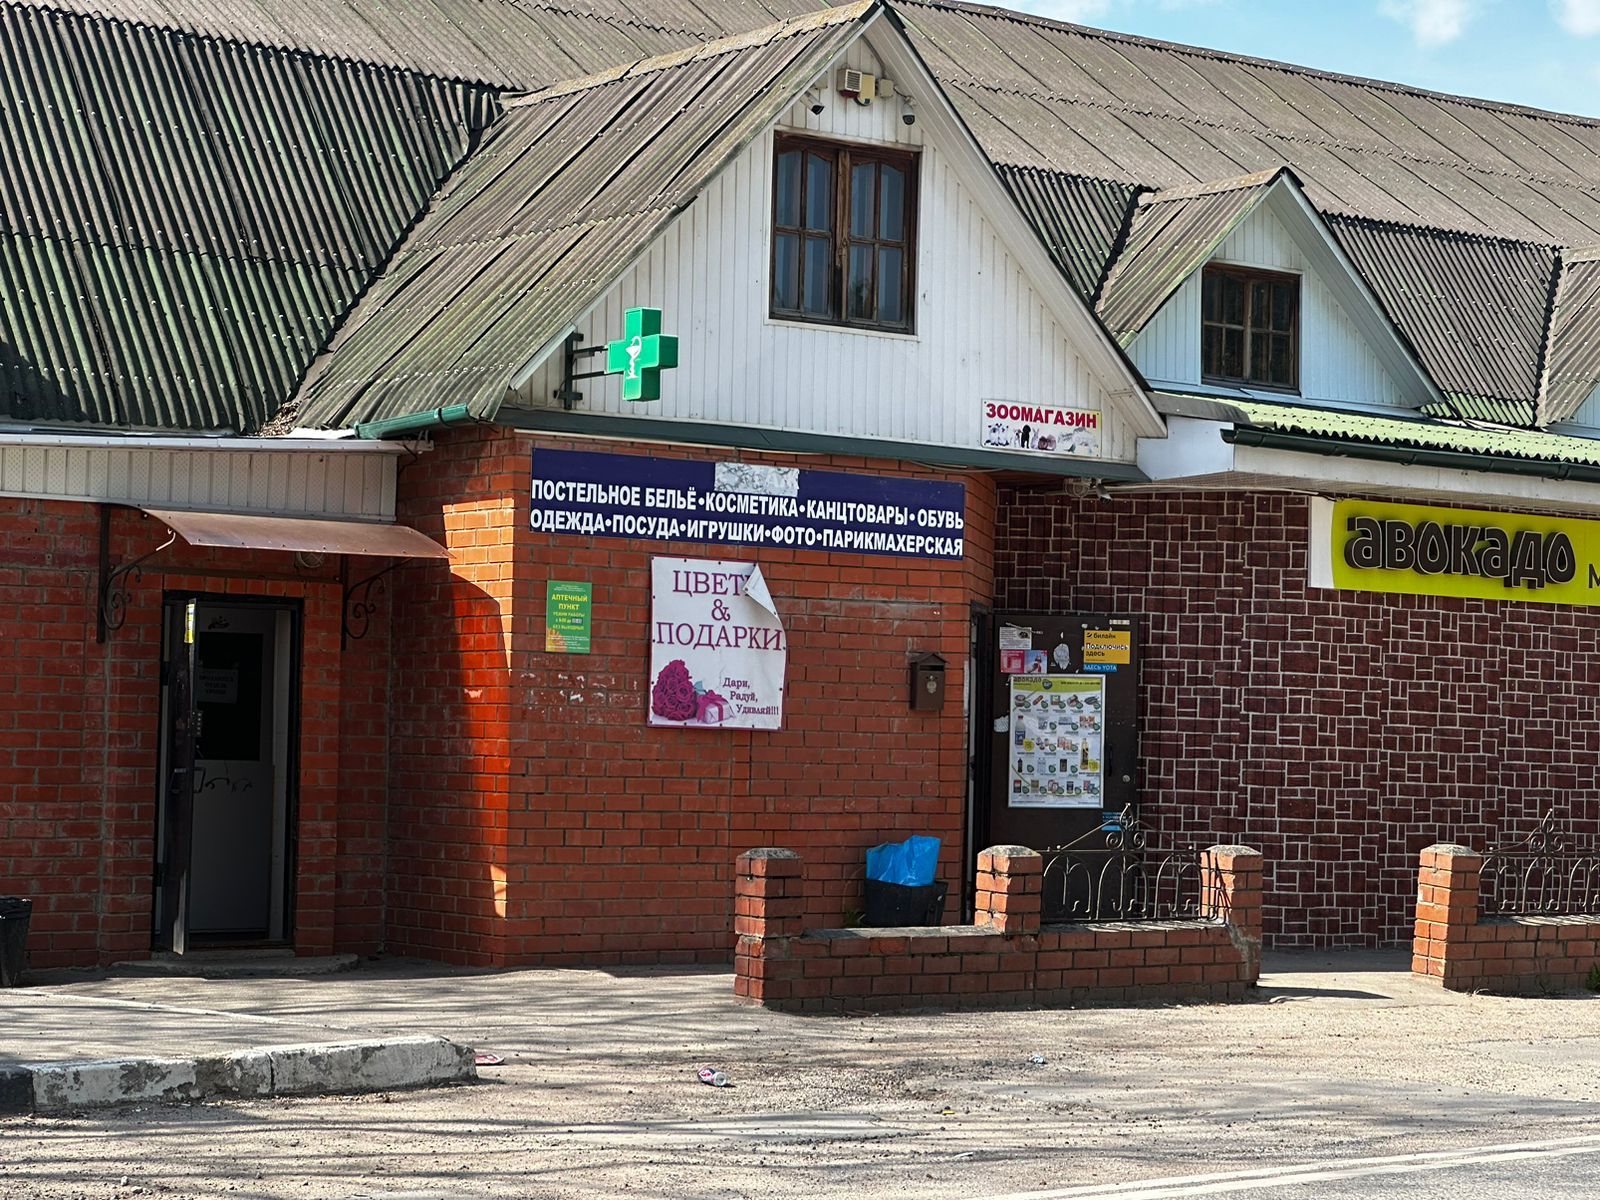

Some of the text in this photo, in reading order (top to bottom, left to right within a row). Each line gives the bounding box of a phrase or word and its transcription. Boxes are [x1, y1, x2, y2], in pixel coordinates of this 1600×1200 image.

[986, 403, 1097, 428] ЗООМАГАЗИН
[531, 480, 964, 529] ПОСТЕЛЬНОЕ БЕЛЬЁ КОСМЕТИКА КАНЦТОВАРЫ ОБУВЬ
[530, 509, 964, 556] ОДЕЖДА ПОСУДА ИГРУШКИ ФОТО ПАРИКМАХЕРСКАЯ
[1344, 516, 1576, 590] авокадо
[673, 570, 750, 597] ЦВЕТ
[551, 593, 588, 602] АПТЕЧНЫЙ
[711, 598, 731, 622] &
[656, 622, 782, 651] ПОДАРКИ
[1085, 642, 1129, 650] Подключись
[722, 677, 750, 689] Дари,
[730, 690, 758, 703] Радуй,
[736, 704, 779, 715] Удивляй!!!
